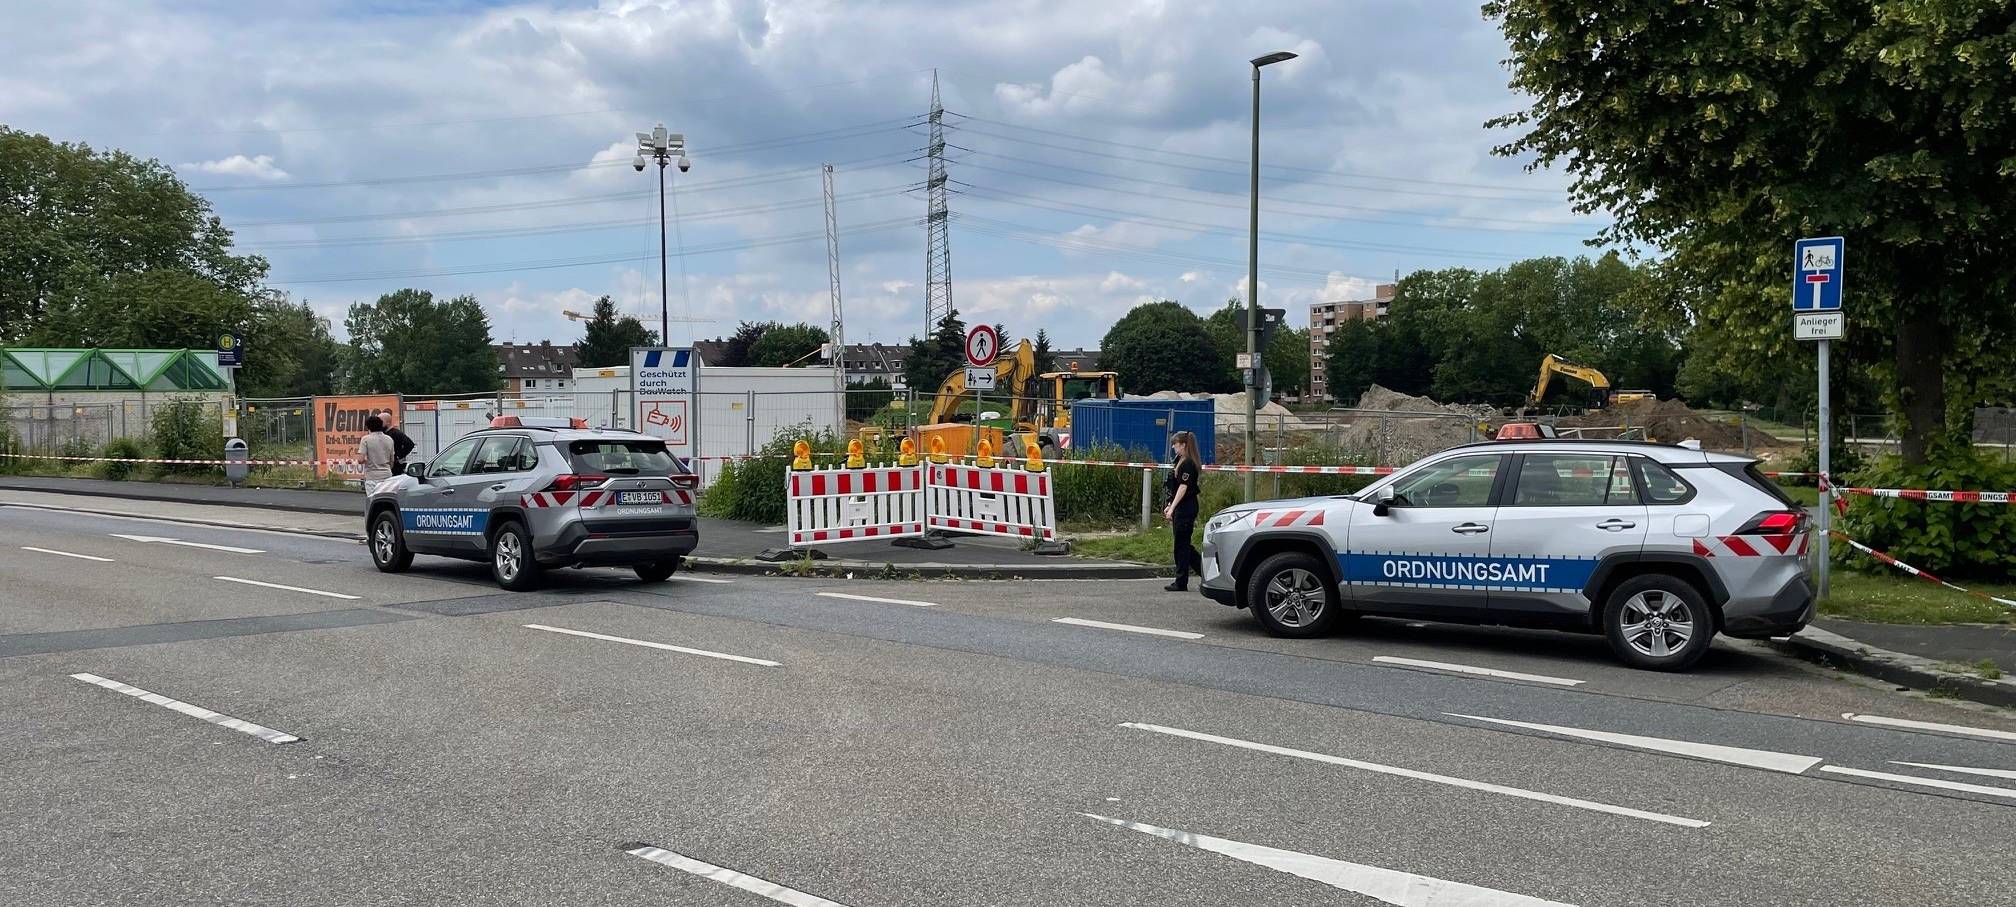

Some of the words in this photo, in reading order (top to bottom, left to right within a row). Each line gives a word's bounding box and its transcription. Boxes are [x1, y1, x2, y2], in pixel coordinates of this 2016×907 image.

[1800, 318, 1838, 327] Anlieger
[1811, 327, 1827, 335] frei
[236, 338, 241, 347] 2
[639, 370, 687, 378] Geschützt
[639, 379, 667, 387] durch
[639, 387, 687, 396] BauWatch
[622, 492, 628, 501] E
[632, 492, 642, 501] VB
[643, 492, 661, 501] 1051
[617, 507, 663, 515] ORDNUNGSAMT
[416, 514, 474, 529] ORDNUNGSAMT
[1383, 559, 1550, 583] ORDNUNGSAMT
